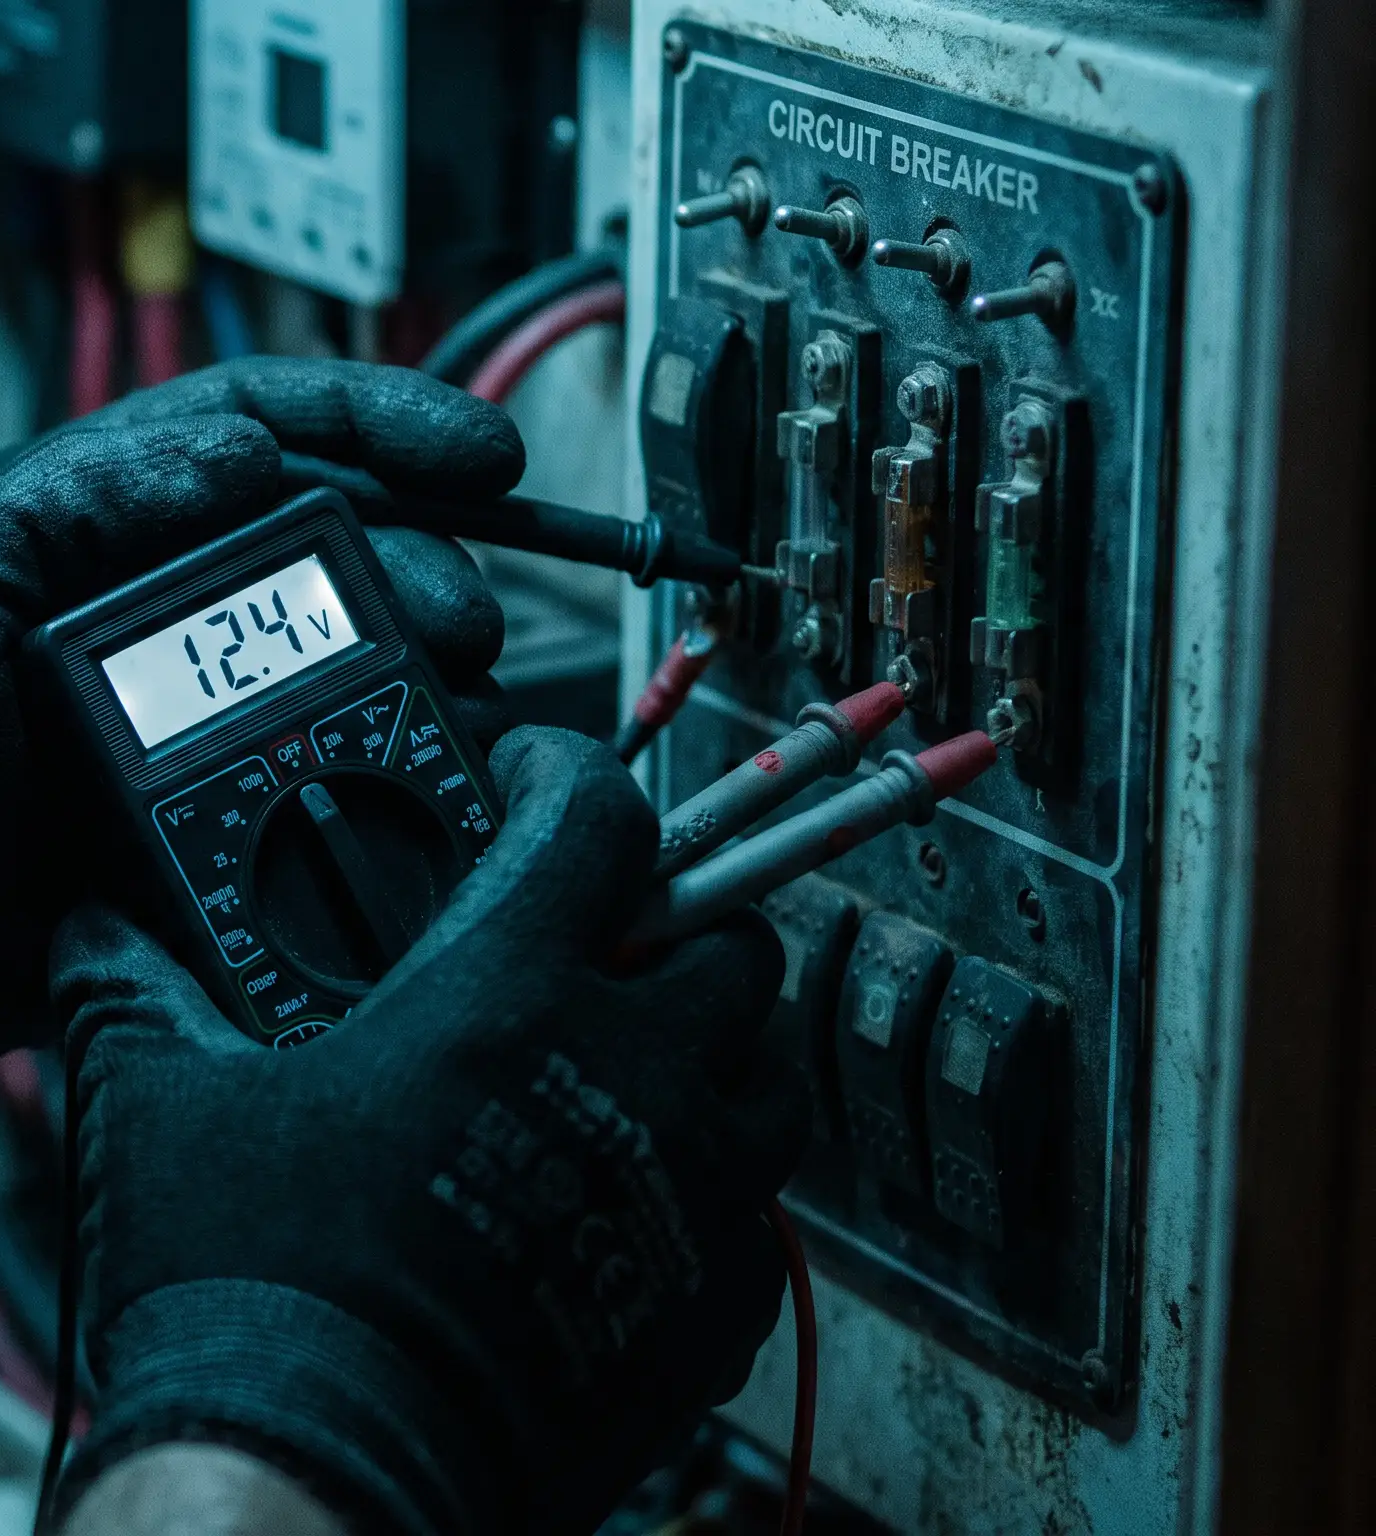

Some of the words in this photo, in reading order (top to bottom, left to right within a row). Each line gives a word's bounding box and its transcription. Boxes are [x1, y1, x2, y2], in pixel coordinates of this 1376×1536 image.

[768, 99, 883, 165] CIRCUIT
[891, 135, 1039, 214] BREAKER
[183, 589, 303, 699] 12.4
[307, 609, 331, 639] V
[277, 741, 301, 763] OFF
